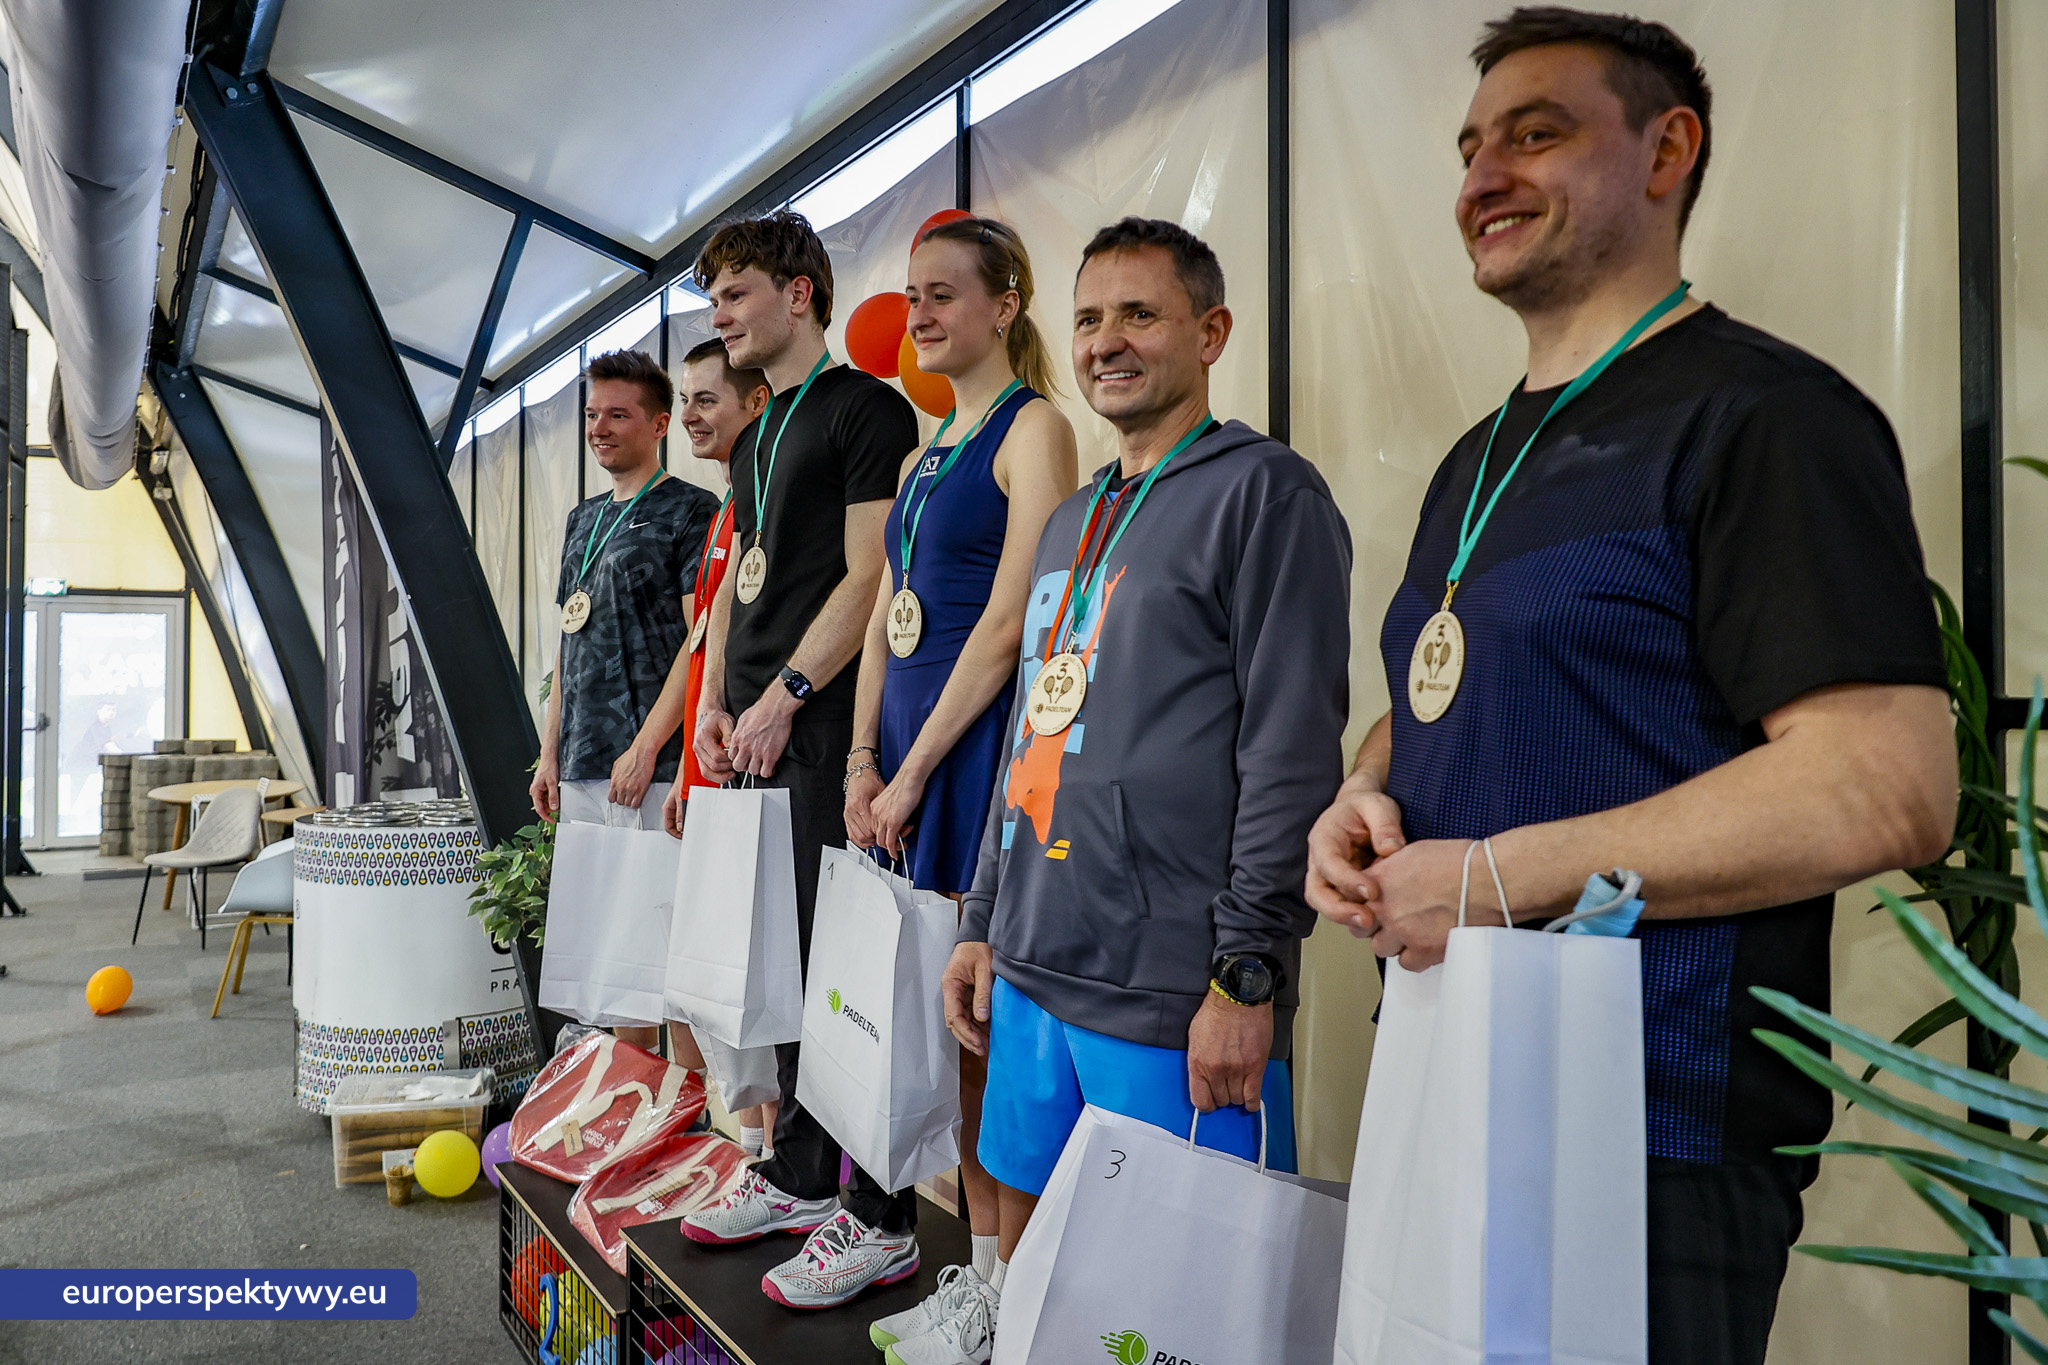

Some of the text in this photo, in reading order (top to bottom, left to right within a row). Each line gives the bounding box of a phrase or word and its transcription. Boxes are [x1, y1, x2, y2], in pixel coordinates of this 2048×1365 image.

[902, 597, 906, 611] 1
[1435, 623, 1445, 647] 3
[1056, 662, 1068, 680] 3
[827, 861, 835, 880] 1
[1104, 1149, 1127, 1179] 3
